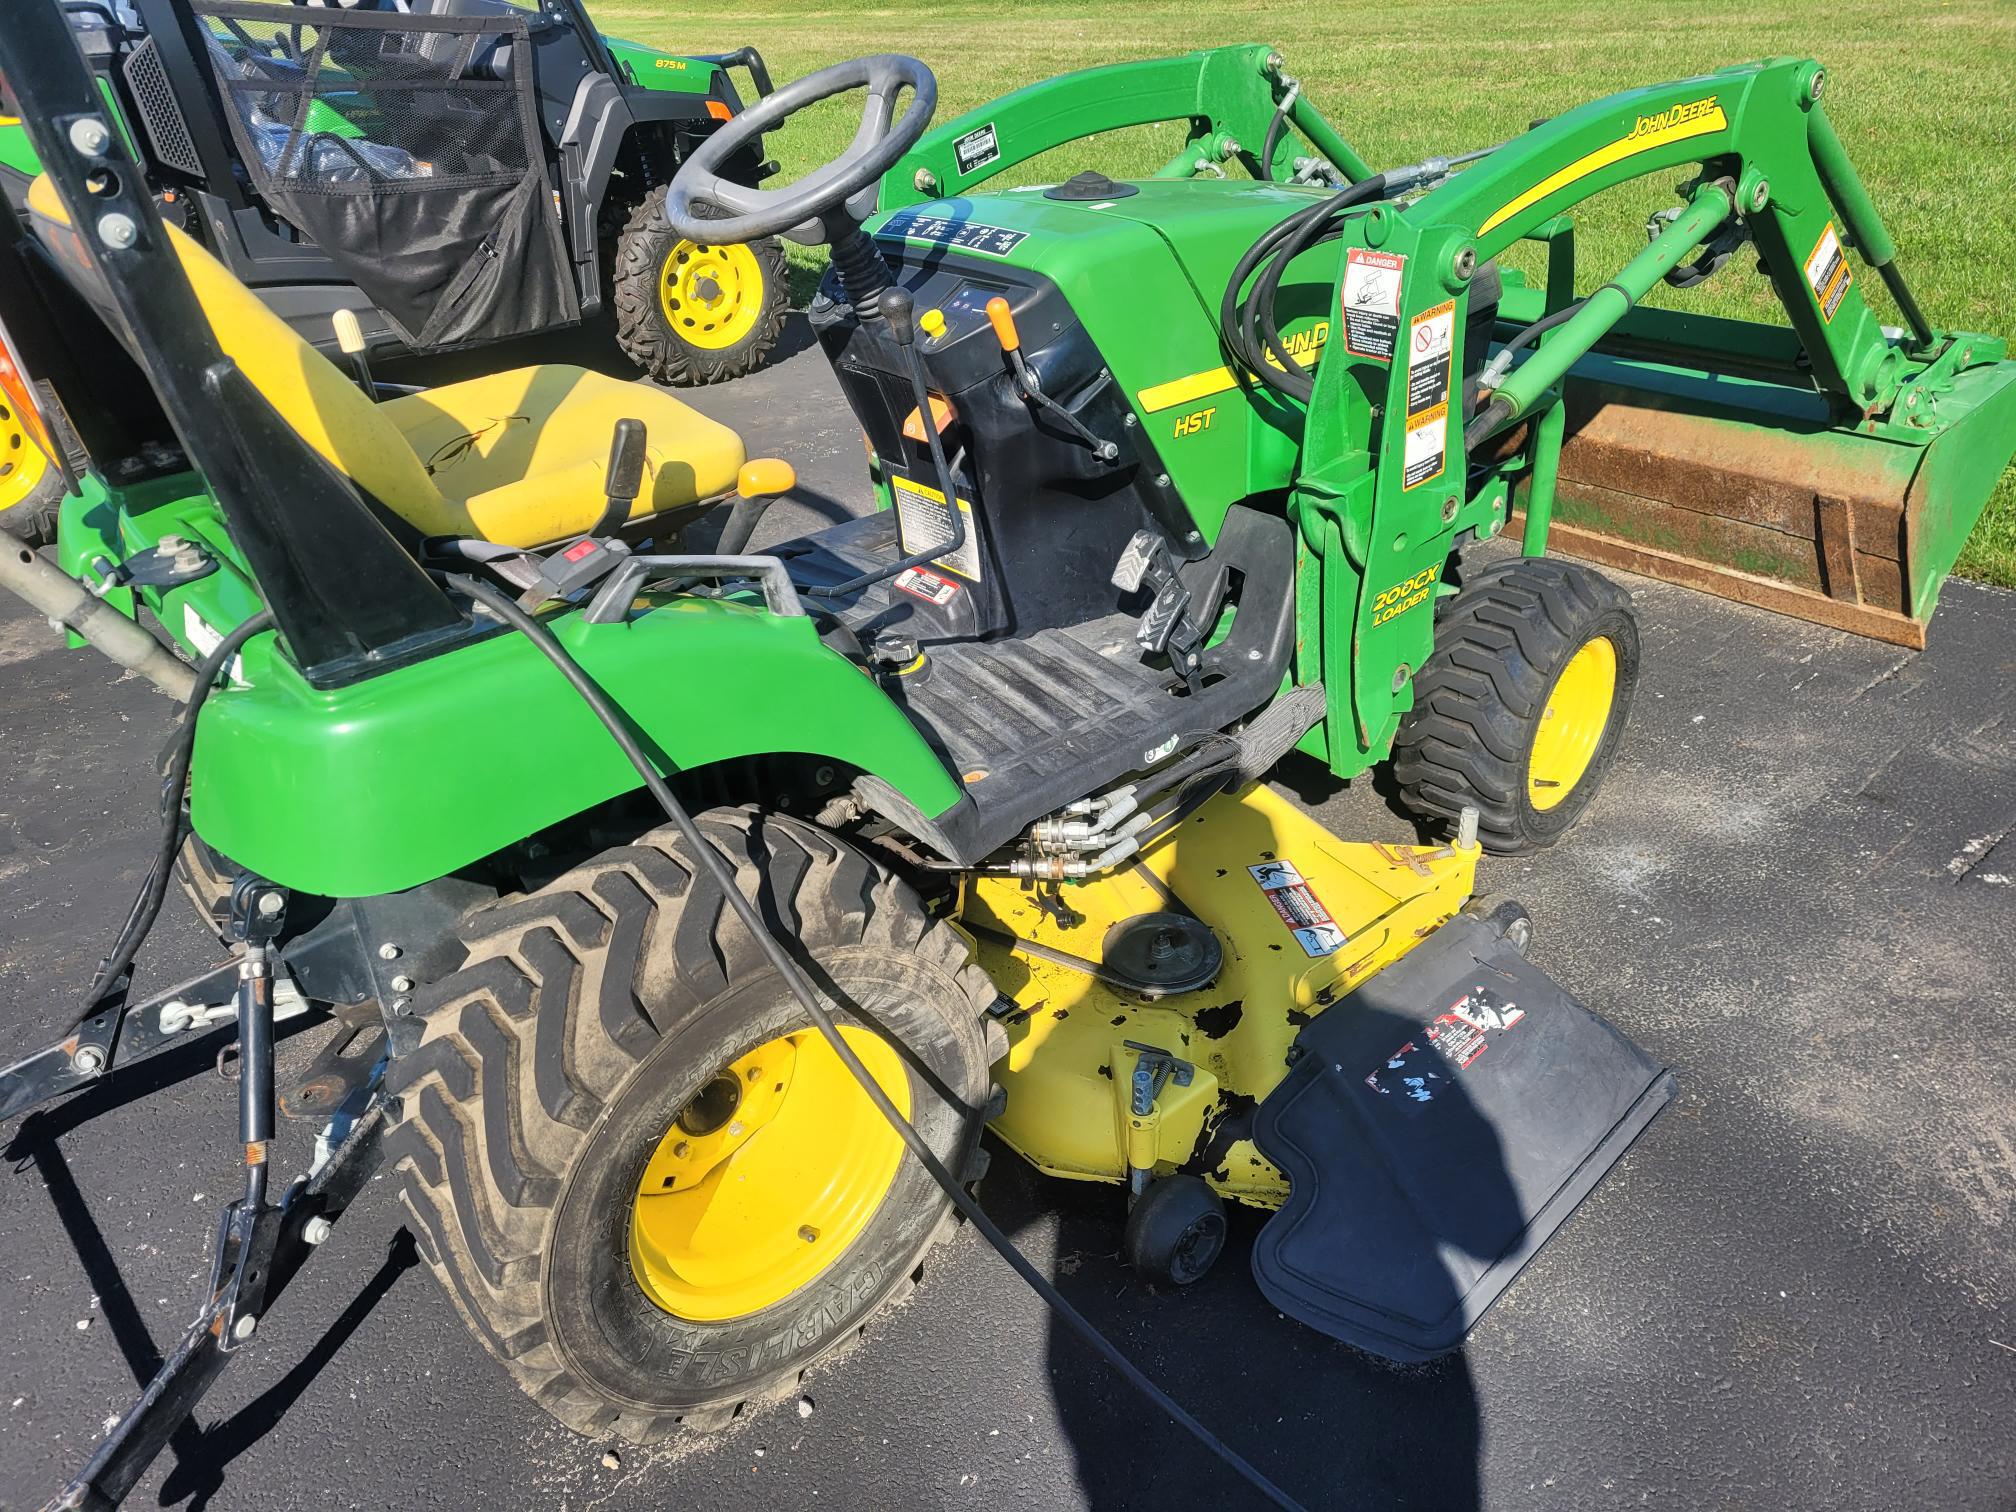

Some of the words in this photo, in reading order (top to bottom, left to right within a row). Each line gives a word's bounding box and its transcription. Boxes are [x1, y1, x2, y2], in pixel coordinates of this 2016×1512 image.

[1628, 110, 1670, 140] JOHN
[1667, 95, 1718, 127] DEERE
[1366, 256, 1398, 268] DANGER
[1420, 301, 1453, 321] WARNING
[1173, 407, 1216, 439] HST
[1415, 407, 1446, 428] WARNING
[1372, 563, 1441, 613] 200CX
[1373, 587, 1430, 627] LOADER
[658, 1261, 885, 1384] CARLISLE
